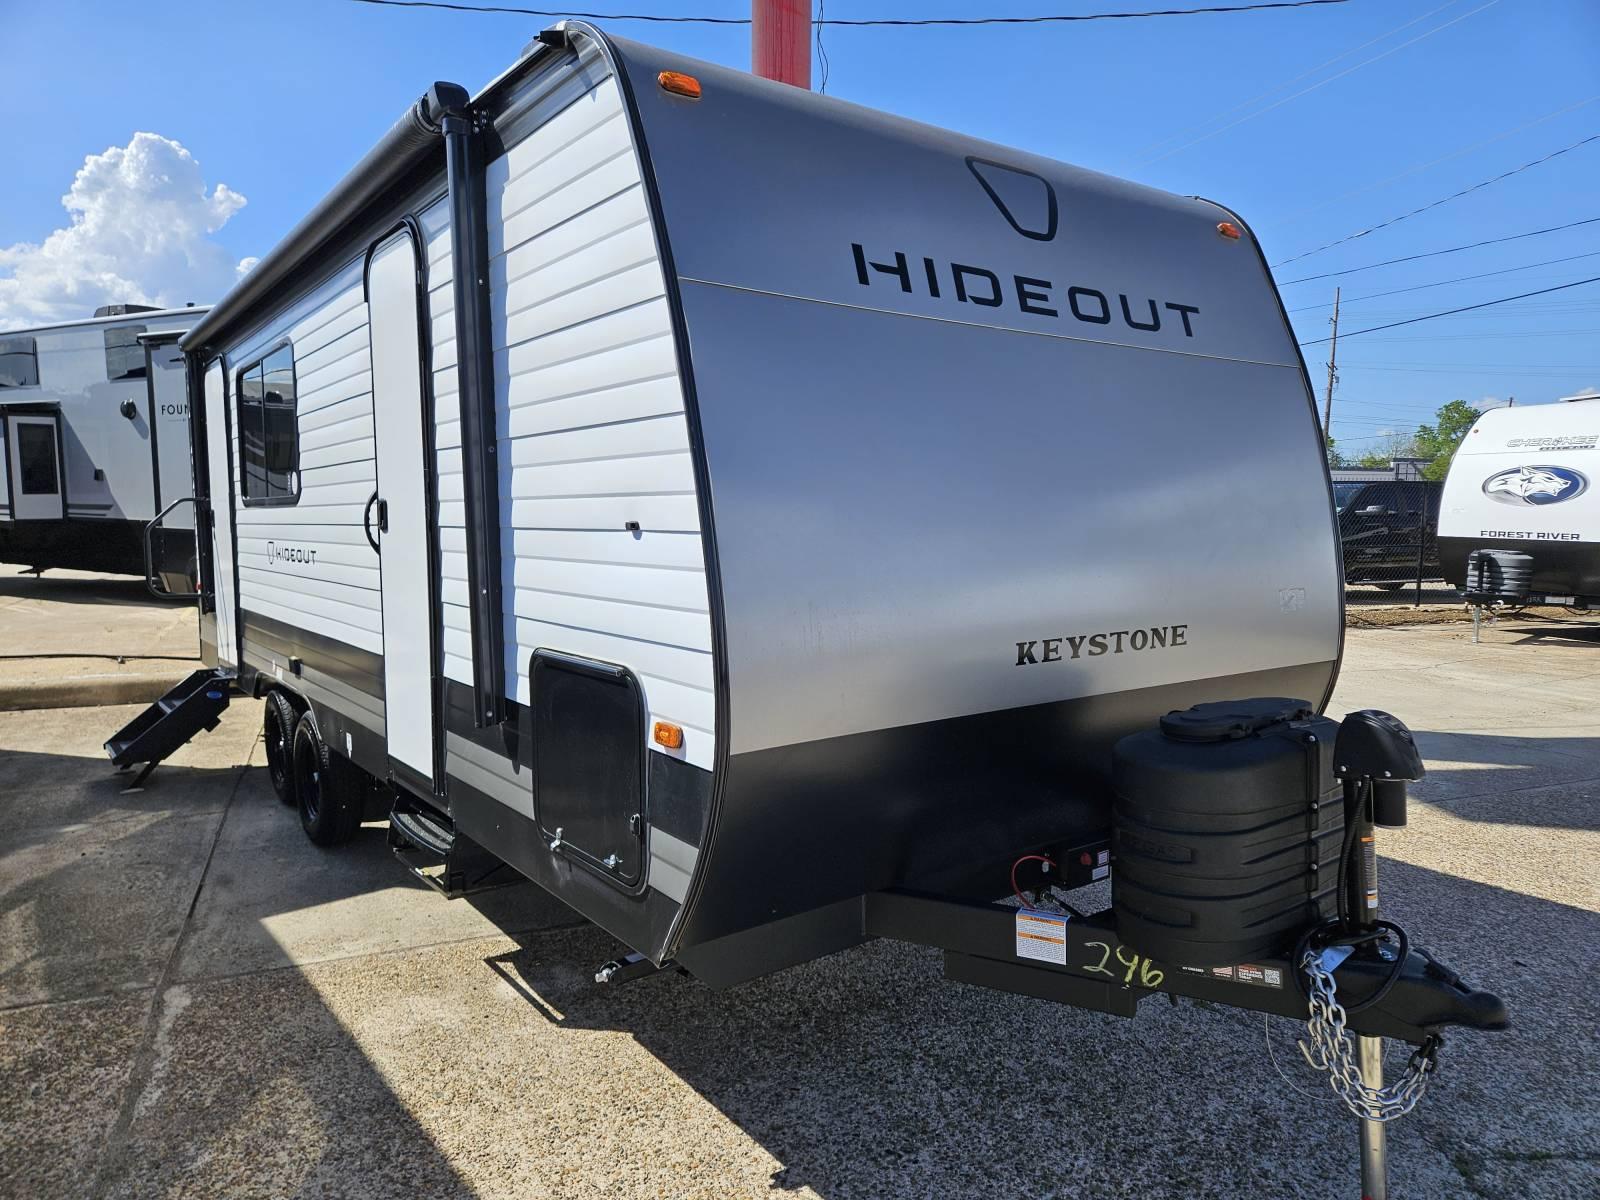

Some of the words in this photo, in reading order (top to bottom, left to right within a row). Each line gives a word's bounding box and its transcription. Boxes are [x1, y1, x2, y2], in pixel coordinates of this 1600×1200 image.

[851, 243, 1200, 337] HIDEOUT
[275, 546, 317, 565] HIDEOUT
[1480, 530, 1533, 539] FOREST
[1537, 532, 1580, 541] RIVER
[1015, 624, 1188, 666] KEYSTONE
[1082, 941, 1164, 988] 246
